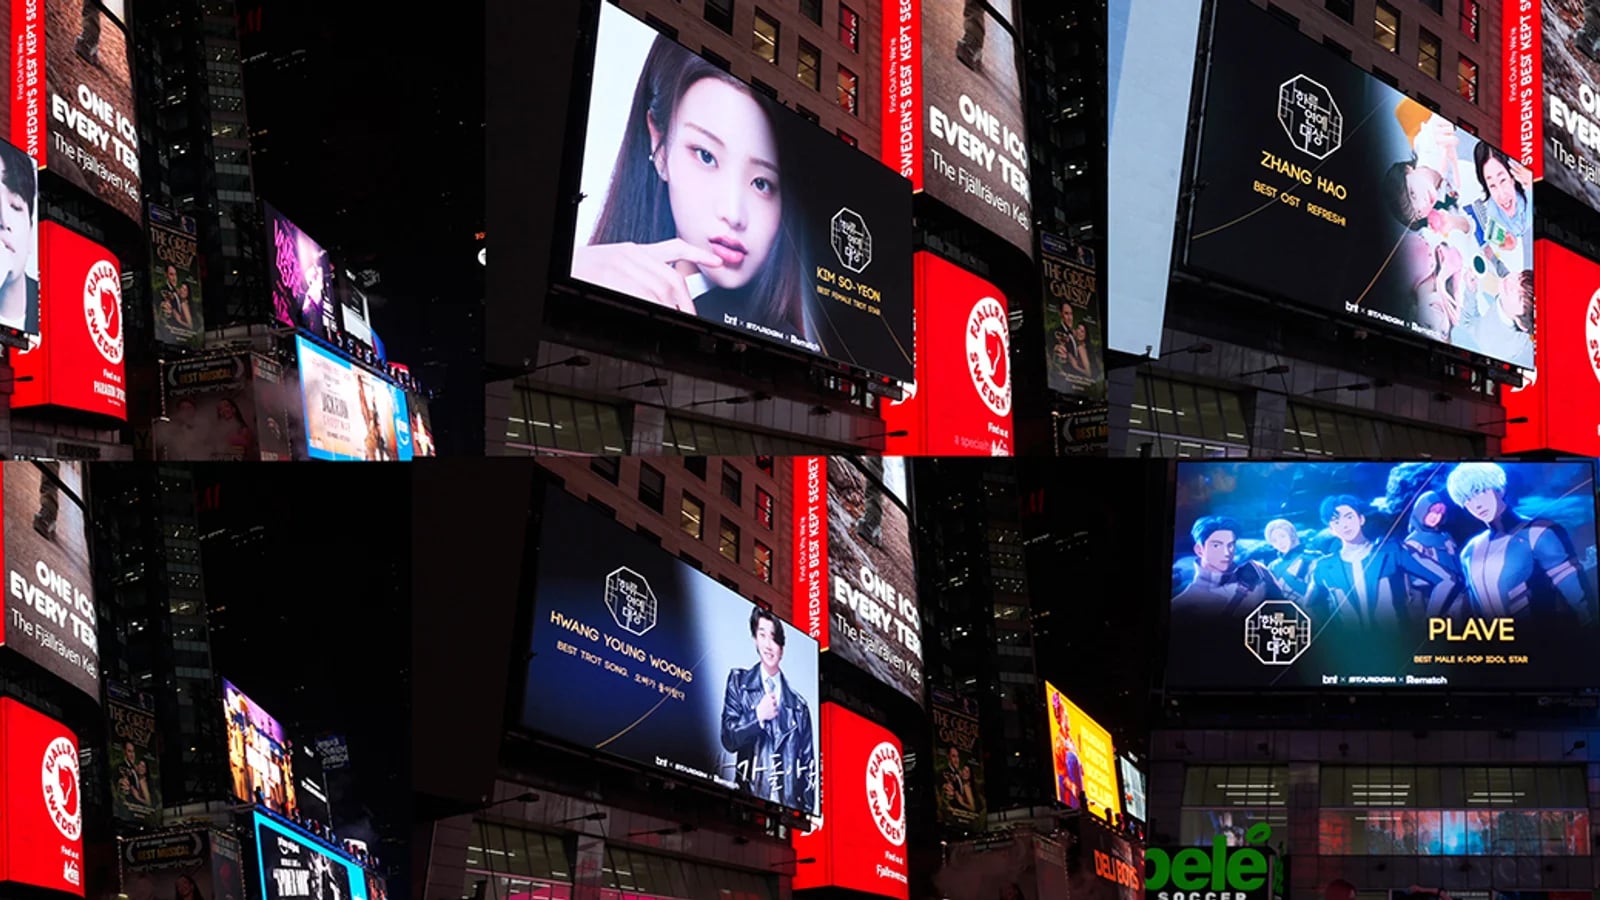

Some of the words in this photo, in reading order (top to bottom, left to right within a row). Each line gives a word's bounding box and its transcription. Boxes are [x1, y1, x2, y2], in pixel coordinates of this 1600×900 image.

[26, 24, 37, 54] KEPT
[900, 25, 912, 61] KEPT
[1520, 15, 1532, 50] KEPT
[26, 58, 38, 85] BEST
[900, 64, 913, 98] BEST
[1520, 53, 1532, 87] BEST
[27, 89, 38, 156] SWEDEN'S
[52, 93, 110, 151] EVERY
[77, 84, 114, 127] ONE
[959, 94, 1001, 145] ONE
[900, 99, 913, 179] SWEDEN'S
[929, 105, 995, 172] EVERY
[1520, 88, 1533, 165] SWEDEN'S
[53, 131, 75, 158] The
[1551, 136, 1576, 170] The
[931, 149, 955, 181] The
[958, 166, 1012, 219] Fjällräven
[1260, 150, 1313, 185] ZHANG
[1317, 176, 1347, 200] HAO
[1253, 180, 1278, 198] BEST
[1280, 192, 1301, 208] OST
[150, 227, 168, 244] THE
[817, 266, 836, 284] KIM
[838, 275, 881, 302] SO-YEON
[1042, 259, 1062, 280] THE
[1063, 266, 1097, 292] GREAT
[1051, 281, 1091, 306] GATSBY
[807, 457, 820, 502] SECRET
[808, 505, 820, 538] KEPT
[808, 539, 820, 568] BEST
[10, 570, 68, 628] EVERY
[36, 561, 73, 605] ONE
[860, 566, 896, 610] ONE
[808, 570, 821, 639] SWEDEN'S
[834, 576, 891, 633] EVERY
[12, 608, 33, 637] The
[835, 613, 857, 642] The
[1429, 618, 1514, 641] PLAVE
[550, 610, 599, 642] HWANG
[603, 633, 646, 662] YOUNG
[650, 655, 693, 683] WOONG
[556, 640, 578, 655] BEST
[580, 650, 602, 666] TROT
[1413, 655, 1433, 663] BEST
[1434, 655, 1456, 663] MALE
[1457, 655, 1483, 663] K-POP
[1485, 655, 1506, 664] IDOL
[1508, 655, 1529, 663] STAR
[1406, 675, 1448, 684] Rematch
[1094, 849, 1117, 882] DELI
[1117, 858, 1139, 892] BOYS
